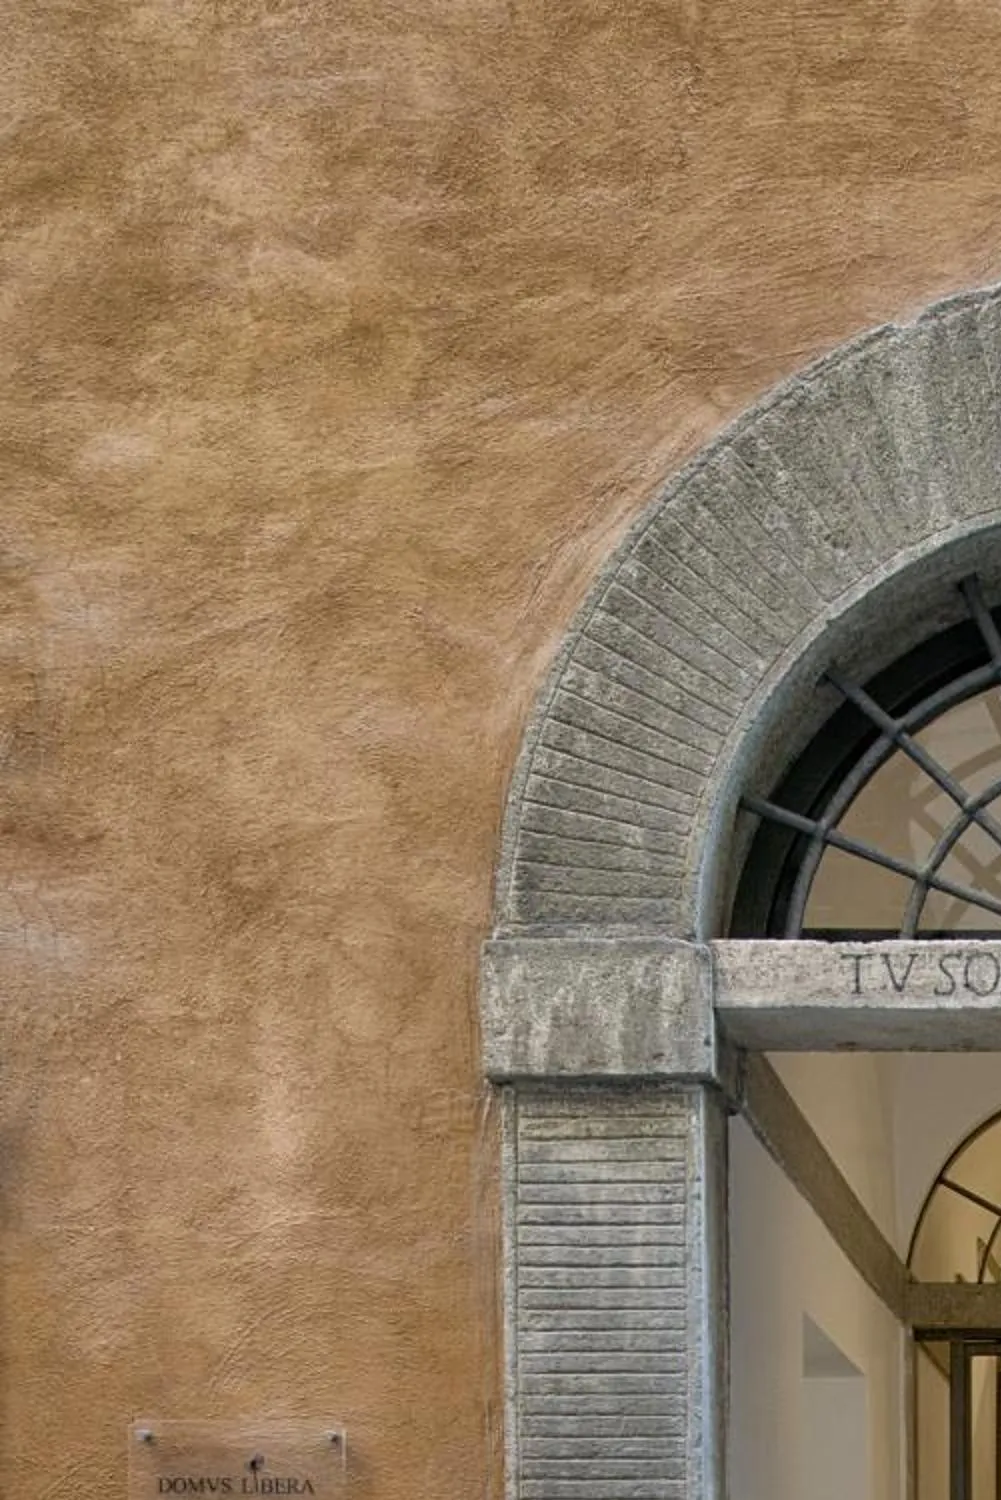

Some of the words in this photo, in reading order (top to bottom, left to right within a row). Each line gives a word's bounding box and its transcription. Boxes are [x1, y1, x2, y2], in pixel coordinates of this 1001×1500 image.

[840, 952, 919, 994] TV
[158, 1477, 233, 1494] DOMVS
[242, 1477, 315, 1495] LIBERA
